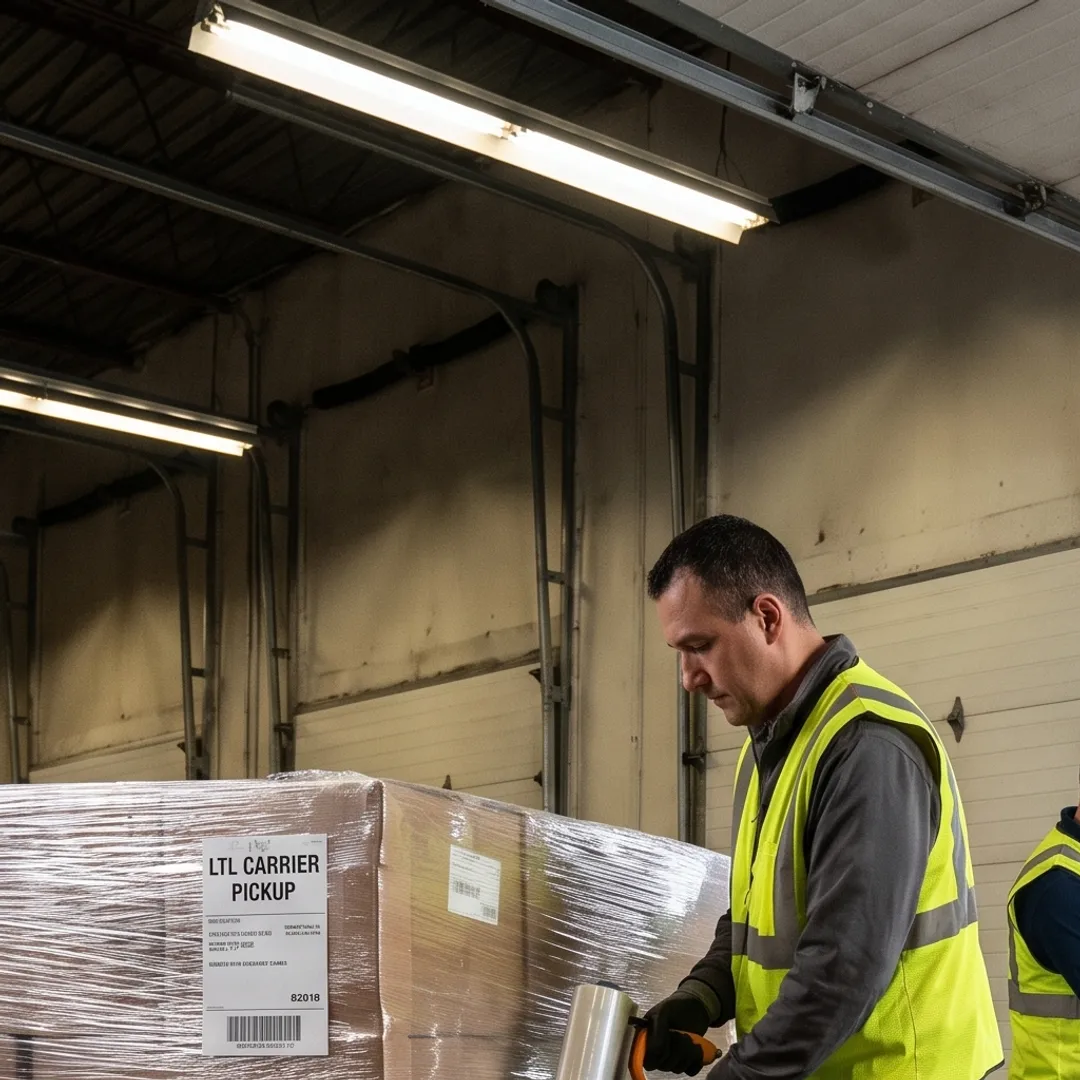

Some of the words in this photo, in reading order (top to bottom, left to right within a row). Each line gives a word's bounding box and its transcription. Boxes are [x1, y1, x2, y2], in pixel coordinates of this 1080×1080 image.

[209, 857, 238, 876] LTL
[243, 854, 320, 875] CARRIER
[232, 881, 296, 902] PICKUP
[290, 993, 321, 1002] 82018
